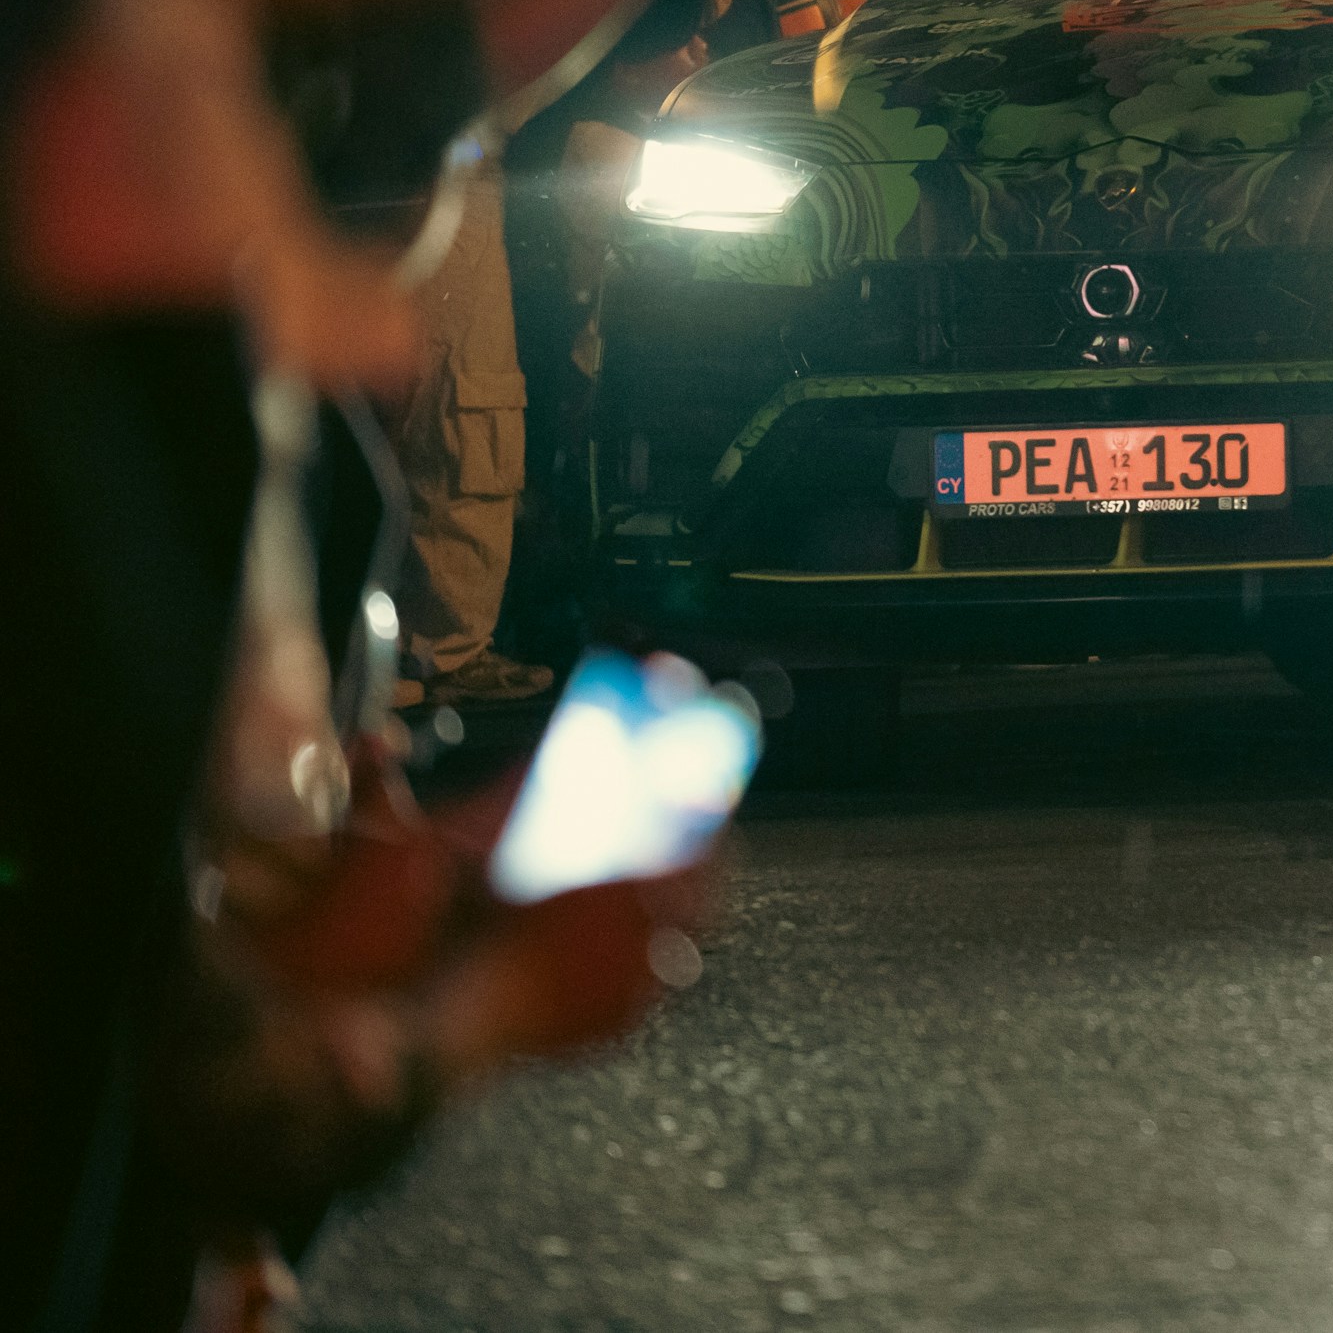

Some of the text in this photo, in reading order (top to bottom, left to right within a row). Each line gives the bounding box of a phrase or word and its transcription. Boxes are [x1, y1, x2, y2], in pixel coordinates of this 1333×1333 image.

[988, 433, 1249, 496] PEA 130
[1110, 453, 1131, 467] 12
[936, 477, 962, 495] CY
[1109, 477, 1129, 491] 21
[968, 498, 1200, 516] PROTO CARS (+357) 99808012
